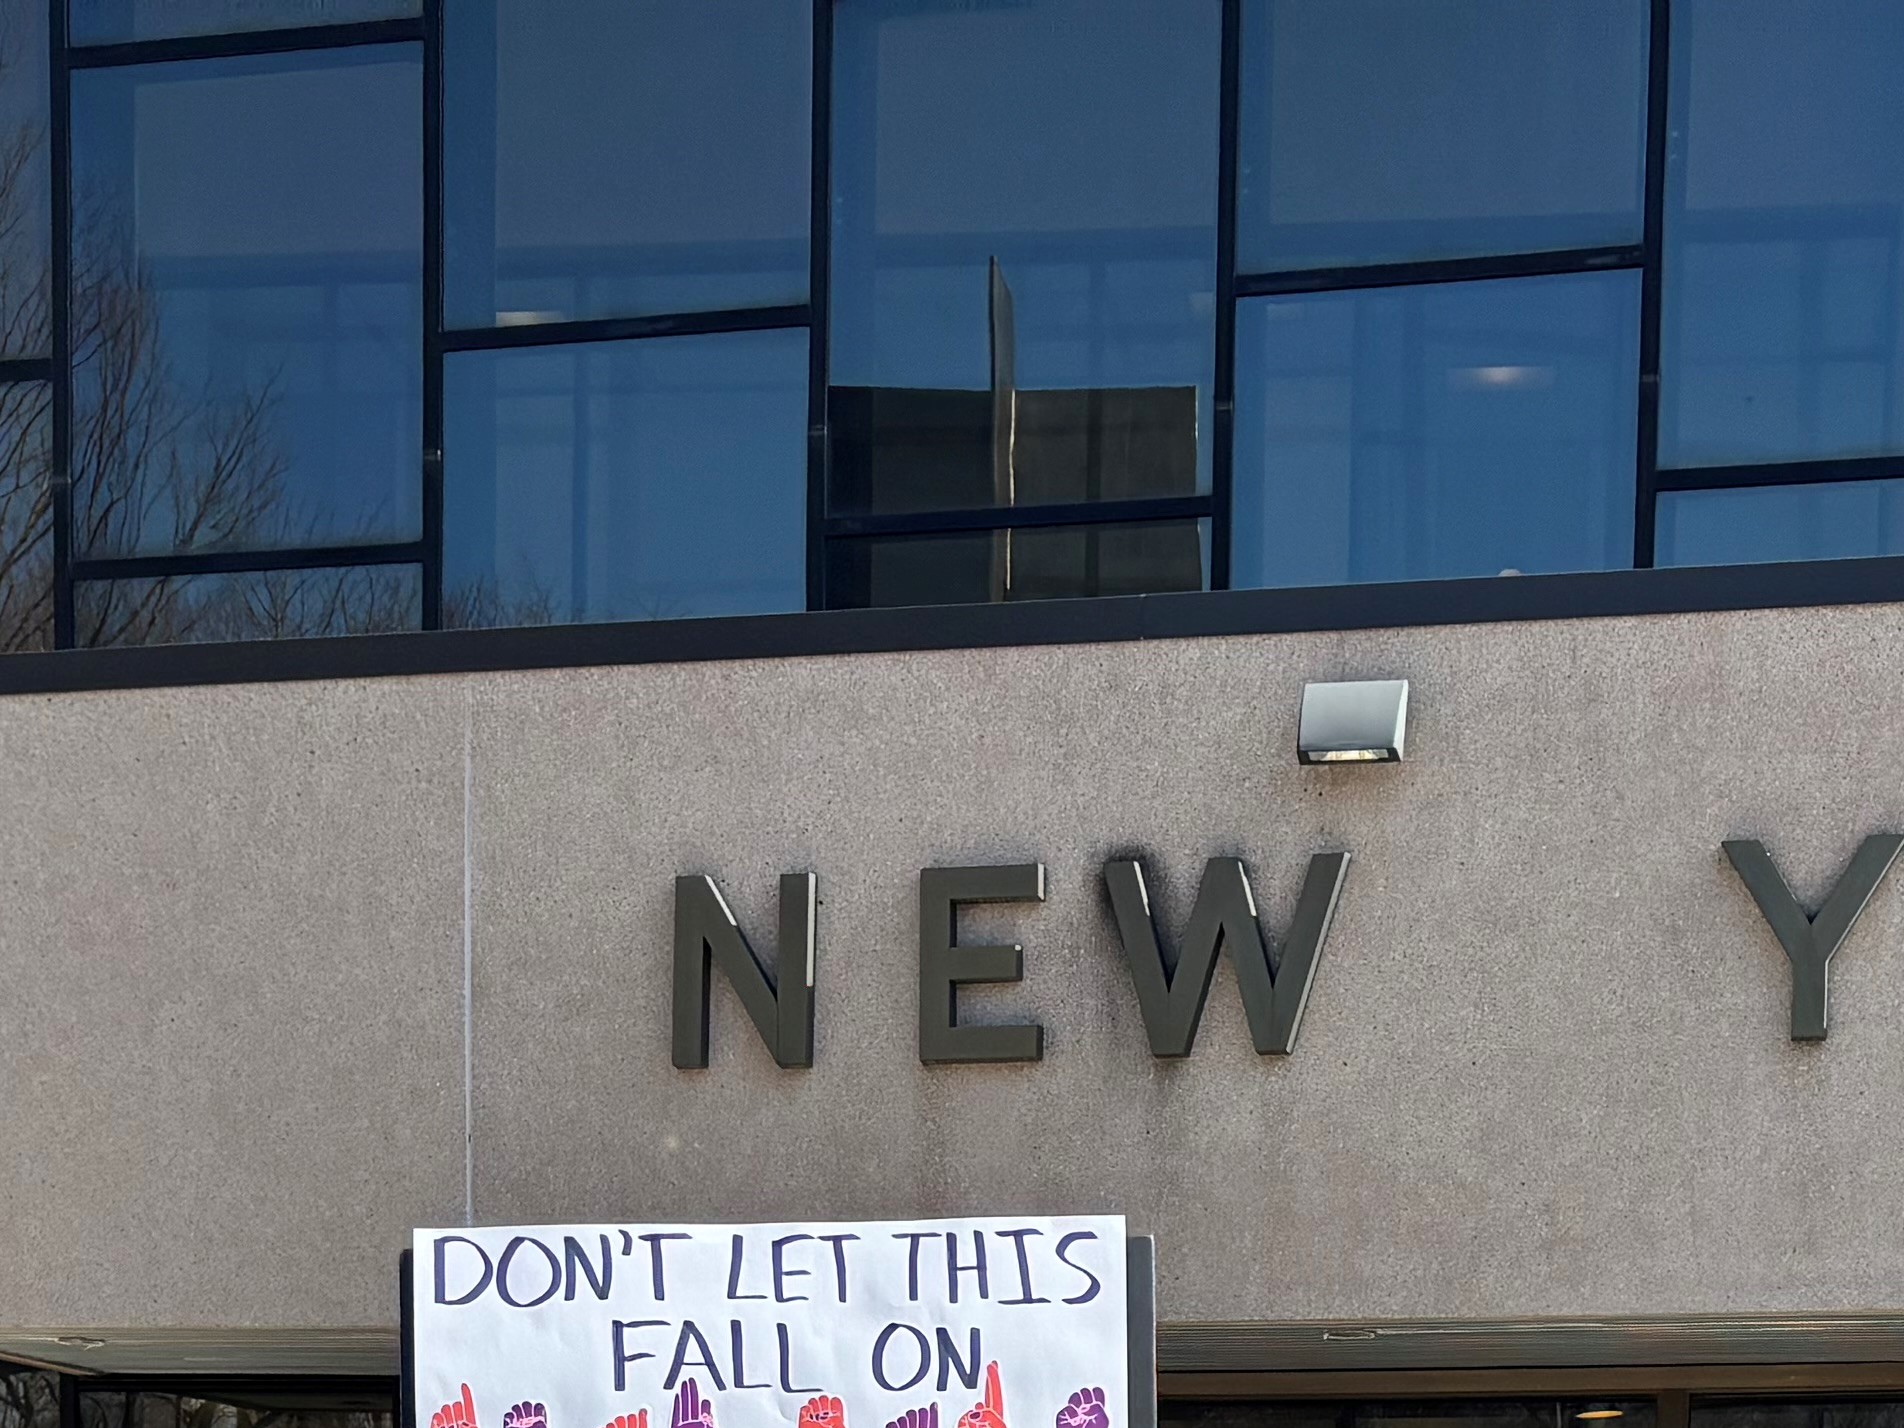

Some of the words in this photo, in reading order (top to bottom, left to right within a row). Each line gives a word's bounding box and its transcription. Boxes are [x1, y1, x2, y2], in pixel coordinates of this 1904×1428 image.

[672, 851, 1352, 1069] NEW
[433, 1229, 692, 1306] DON'T
[727, 1233, 859, 1303] LET
[892, 1228, 1102, 1305] THIS
[612, 1319, 823, 1393] FALL
[872, 1323, 981, 1392] ON
